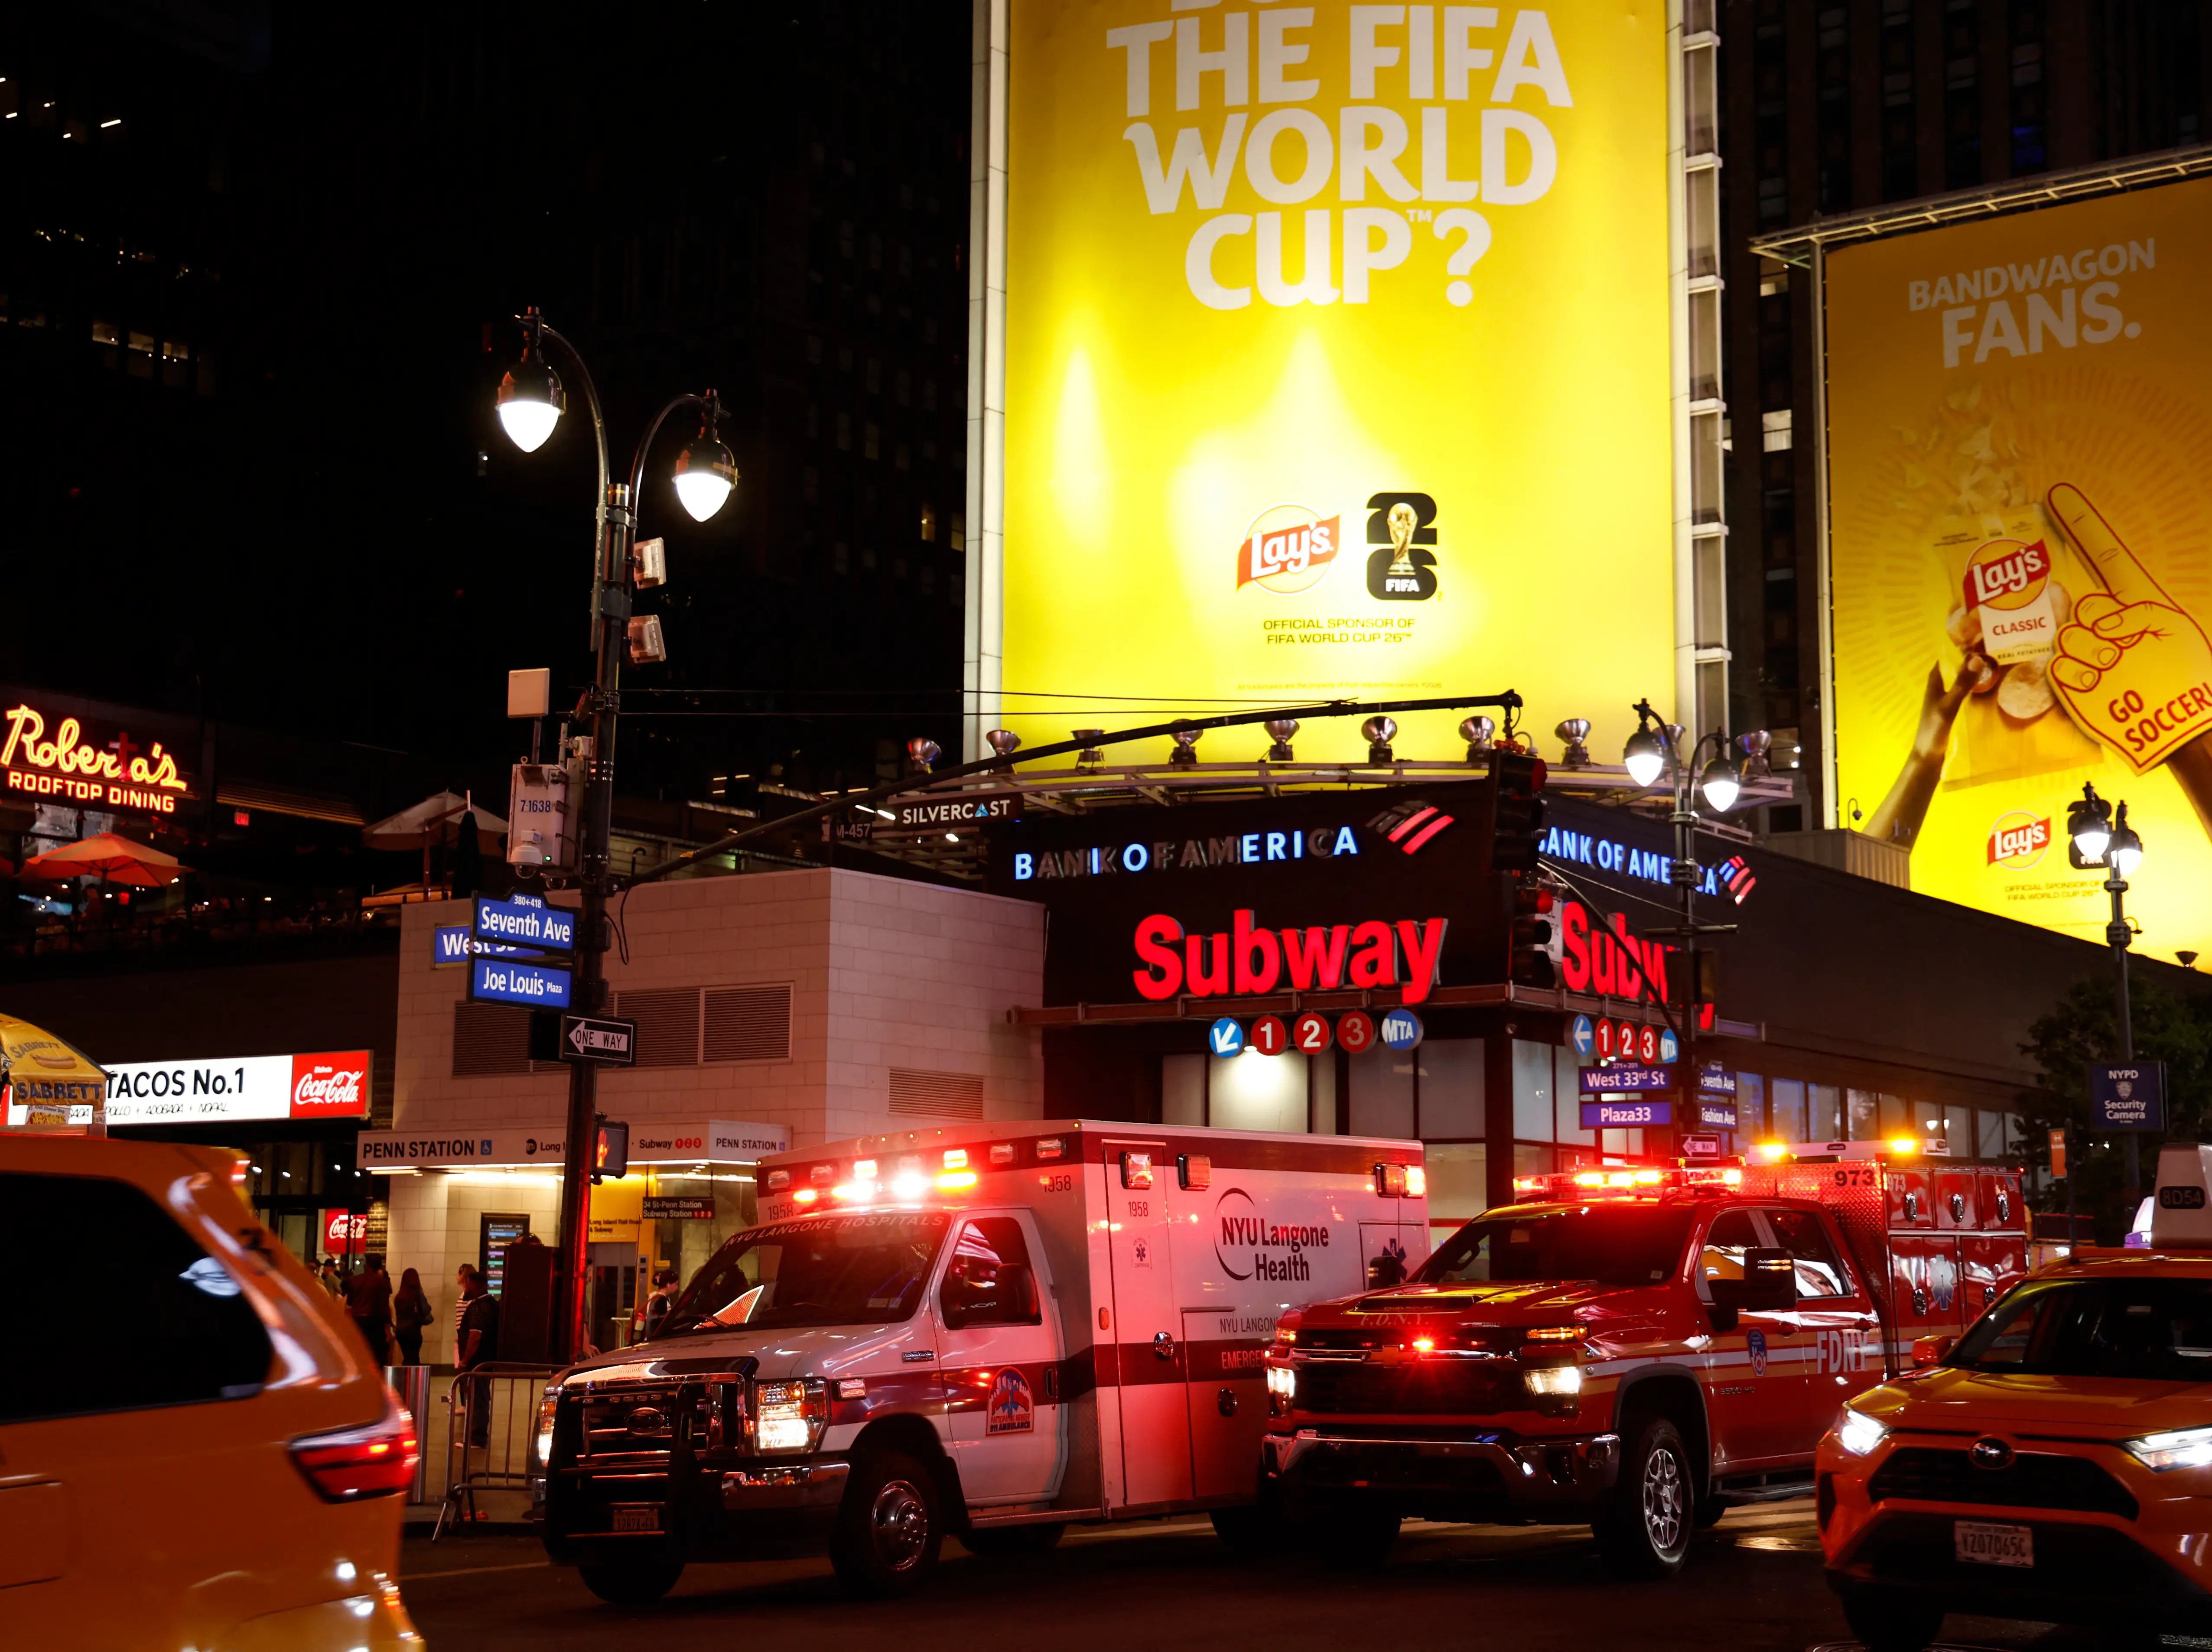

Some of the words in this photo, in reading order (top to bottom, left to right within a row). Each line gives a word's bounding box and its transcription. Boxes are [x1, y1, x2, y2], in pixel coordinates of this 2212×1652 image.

[1106, 8, 1319, 117] THE
[1349, 5, 1574, 108] FIFA
[1122, 105, 1557, 215] WORLD
[1909, 238, 2155, 311] BANDWAGON
[1942, 281, 2141, 368] FANS.
[1386, 579, 1419, 592] FIFA
[1263, 620, 1324, 630] OFFICIAL
[1327, 619, 1394, 628] SPONSOR
[1397, 618, 1415, 628] OF
[1993, 616, 2046, 636] CLASSIC
[1267, 634, 1295, 644] FIFA
[1300, 633, 1349, 643] WORLD
[1353, 633, 1381, 642] CUP
[2108, 690, 2144, 723] GO
[9, 771, 102, 800] ROOFTOP
[109, 787, 174, 813] DINING
[1015, 846, 1118, 880] BANK
[1122, 841, 1174, 872] OF
[1181, 826, 1358, 867] AMERICA
[1539, 826, 1593, 865] ANK
[1597, 839, 1623, 871] OF
[2005, 885, 2043, 893] OFFICIAL
[2045, 881, 2088, 890] SPONSOR
[2007, 893, 2026, 901] FIFA
[2028, 891, 2059, 901] WORLD
[2061, 890, 2080, 898] CUP
[482, 907, 540, 937] Seventh
[543, 917, 570, 942] Ave
[1133, 909, 1448, 1005] Subway
[484, 967, 506, 991] Joe
[511, 970, 543, 996] Louis
[547, 982, 563, 994] Plaza
[576, 1030, 594, 1046] ONE
[603, 1033, 622, 1049] WAY
[1260, 1023, 1273, 1049] 1
[1303, 1020, 1321, 1047] 2
[1346, 1018, 1365, 1044] 3
[1383, 1018, 1413, 1042] MTA
[10, 1041, 60, 1059] SABRETT
[1623, 1028, 1633, 1056] 2
[1643, 1031, 1653, 1057] 3
[107, 1070, 185, 1099] TACOS
[194, 1068, 244, 1095] No.1
[1587, 1073, 1620, 1087] West
[1624, 1070, 1648, 1086] 33rd
[1651, 1071, 1665, 1085] St
[1723, 1076, 1735, 1091] Ave
[2108, 1070, 2138, 1080] NYPD
[16, 1082, 103, 1099] SABRETT
[295, 1071, 364, 1105] Coca-Cola
[146, 1104, 183, 1115] ADOBADA
[2105, 1099, 2146, 1111] Security
[1600, 1107, 1651, 1122] Plaza33
[1701, 1107, 1724, 1124] Fashion
[1724, 1110, 1736, 1125] Ave
[2106, 1110, 2146, 1120] Camera
[363, 1142, 405, 1158] PENN
[409, 1139, 475, 1157] STATION
[540, 1141, 560, 1153] Long
[639, 1139, 672, 1150] Subway
[716, 1138, 739, 1148] PENN
[742, 1139, 777, 1151] STATION
[1686, 1142, 1697, 1151] ONE
[1701, 1142, 1713, 1151] WAY
[1043, 1176, 1072, 1193] 1958
[1835, 1171, 1874, 1187] 973
[1887, 1173, 1906, 1191] 973
[2162, 1189, 2202, 1206] 8D54
[643, 1210, 667, 1218] Subway
[768, 1204, 793, 1220] 1958
[1128, 1201, 1148, 1216] 1958
[726, 1232, 754, 1247] NYU
[757, 1219, 836, 1239] LANGONE
[838, 1215, 944, 1228] HOSPITALS
[1222, 1217, 1258, 1246] NYU
[1261, 1224, 1329, 1253] Langone
[1255, 1253, 1310, 1281] Health
[1220, 1318, 1237, 1333] NYU
[1241, 1317, 1278, 1332] LANGON
[1817, 1330, 1869, 1373] FDNY
[1015, 1413, 1030, 1422] MEMBER
[990, 1424, 998, 1432] 911
[999, 1421, 1030, 1431] AMBULANCE
